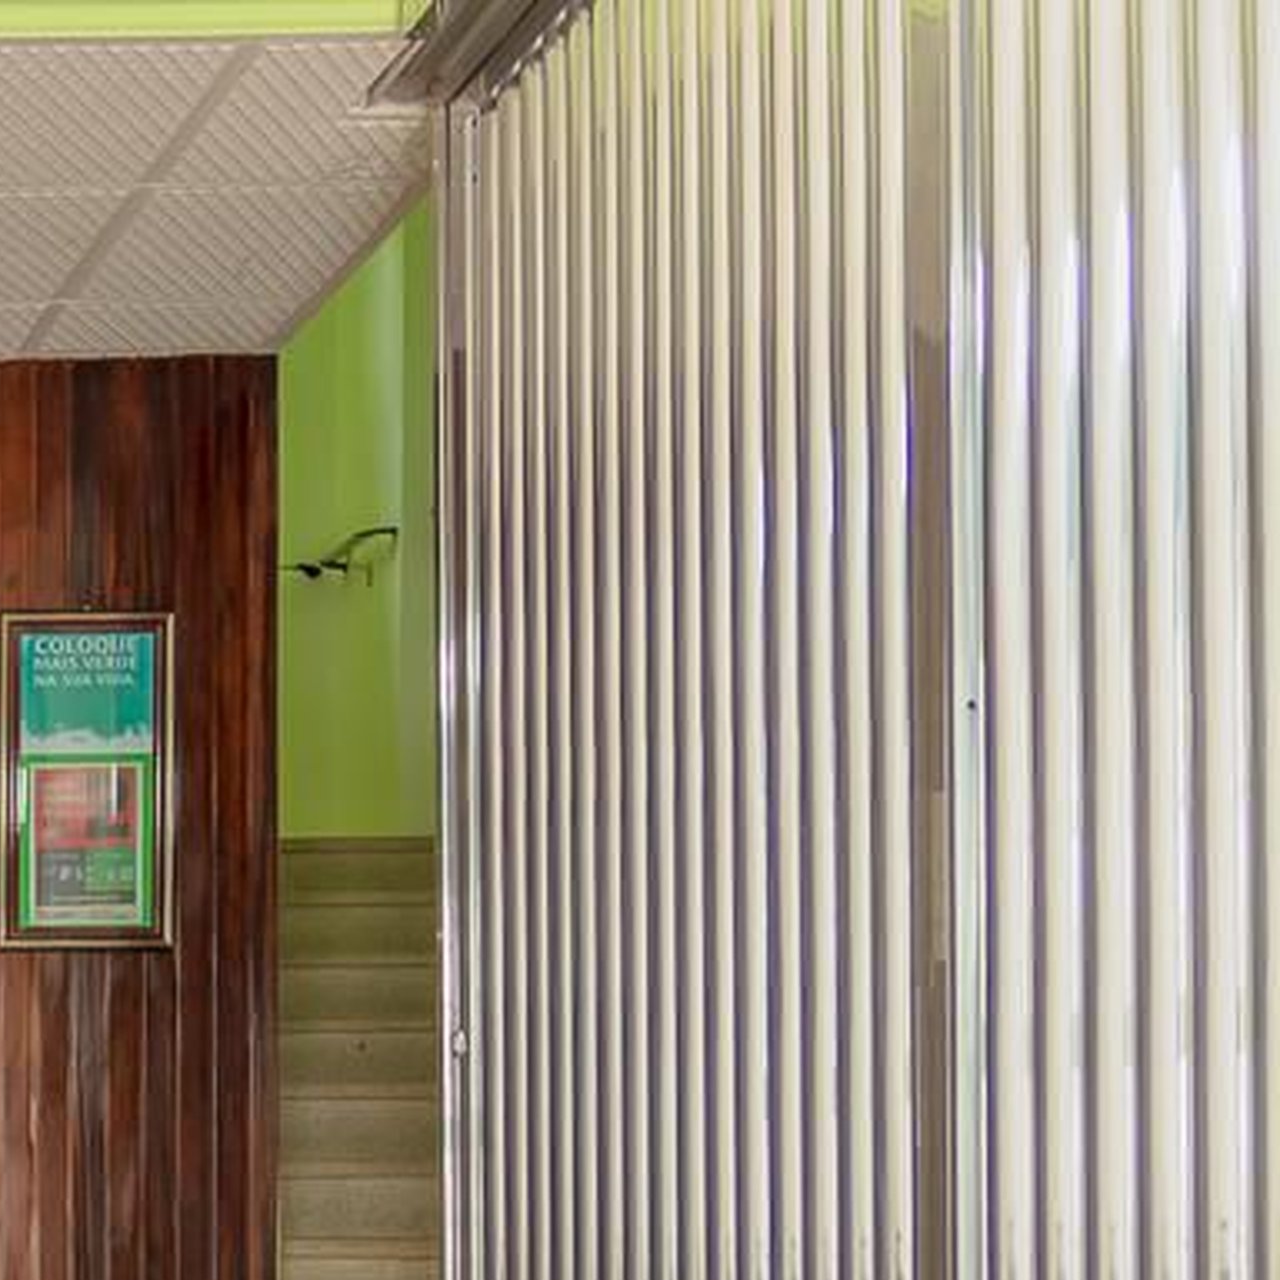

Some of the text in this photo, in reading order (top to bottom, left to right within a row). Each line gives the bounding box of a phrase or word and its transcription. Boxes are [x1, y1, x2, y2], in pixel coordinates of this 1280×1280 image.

[34, 636, 135, 654] COLOQUE
[33, 655, 78, 671] MAIS
[33, 673, 57, 688] NA
